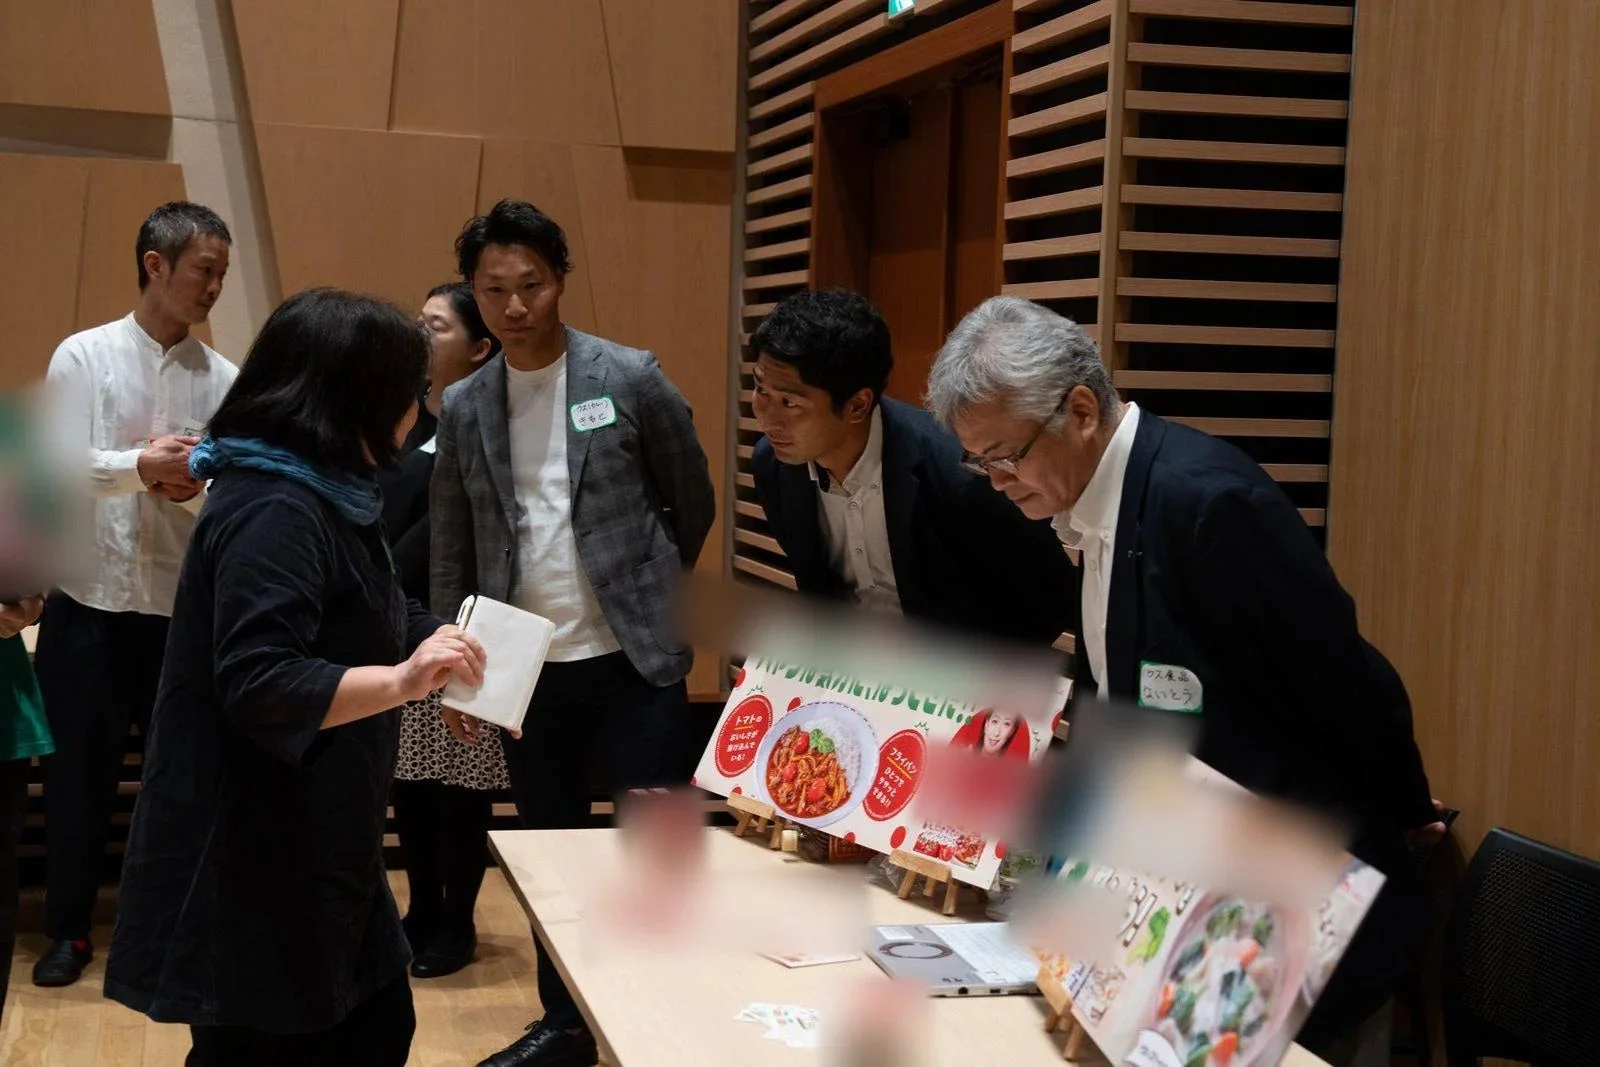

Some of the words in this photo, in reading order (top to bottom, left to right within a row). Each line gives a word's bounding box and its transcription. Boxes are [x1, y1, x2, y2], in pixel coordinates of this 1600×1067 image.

[735, 714, 763, 726] トマトの
[729, 730, 759, 742] おいしさが
[889, 747, 917, 774] フライパン
[884, 766, 905, 788] ひとつで
